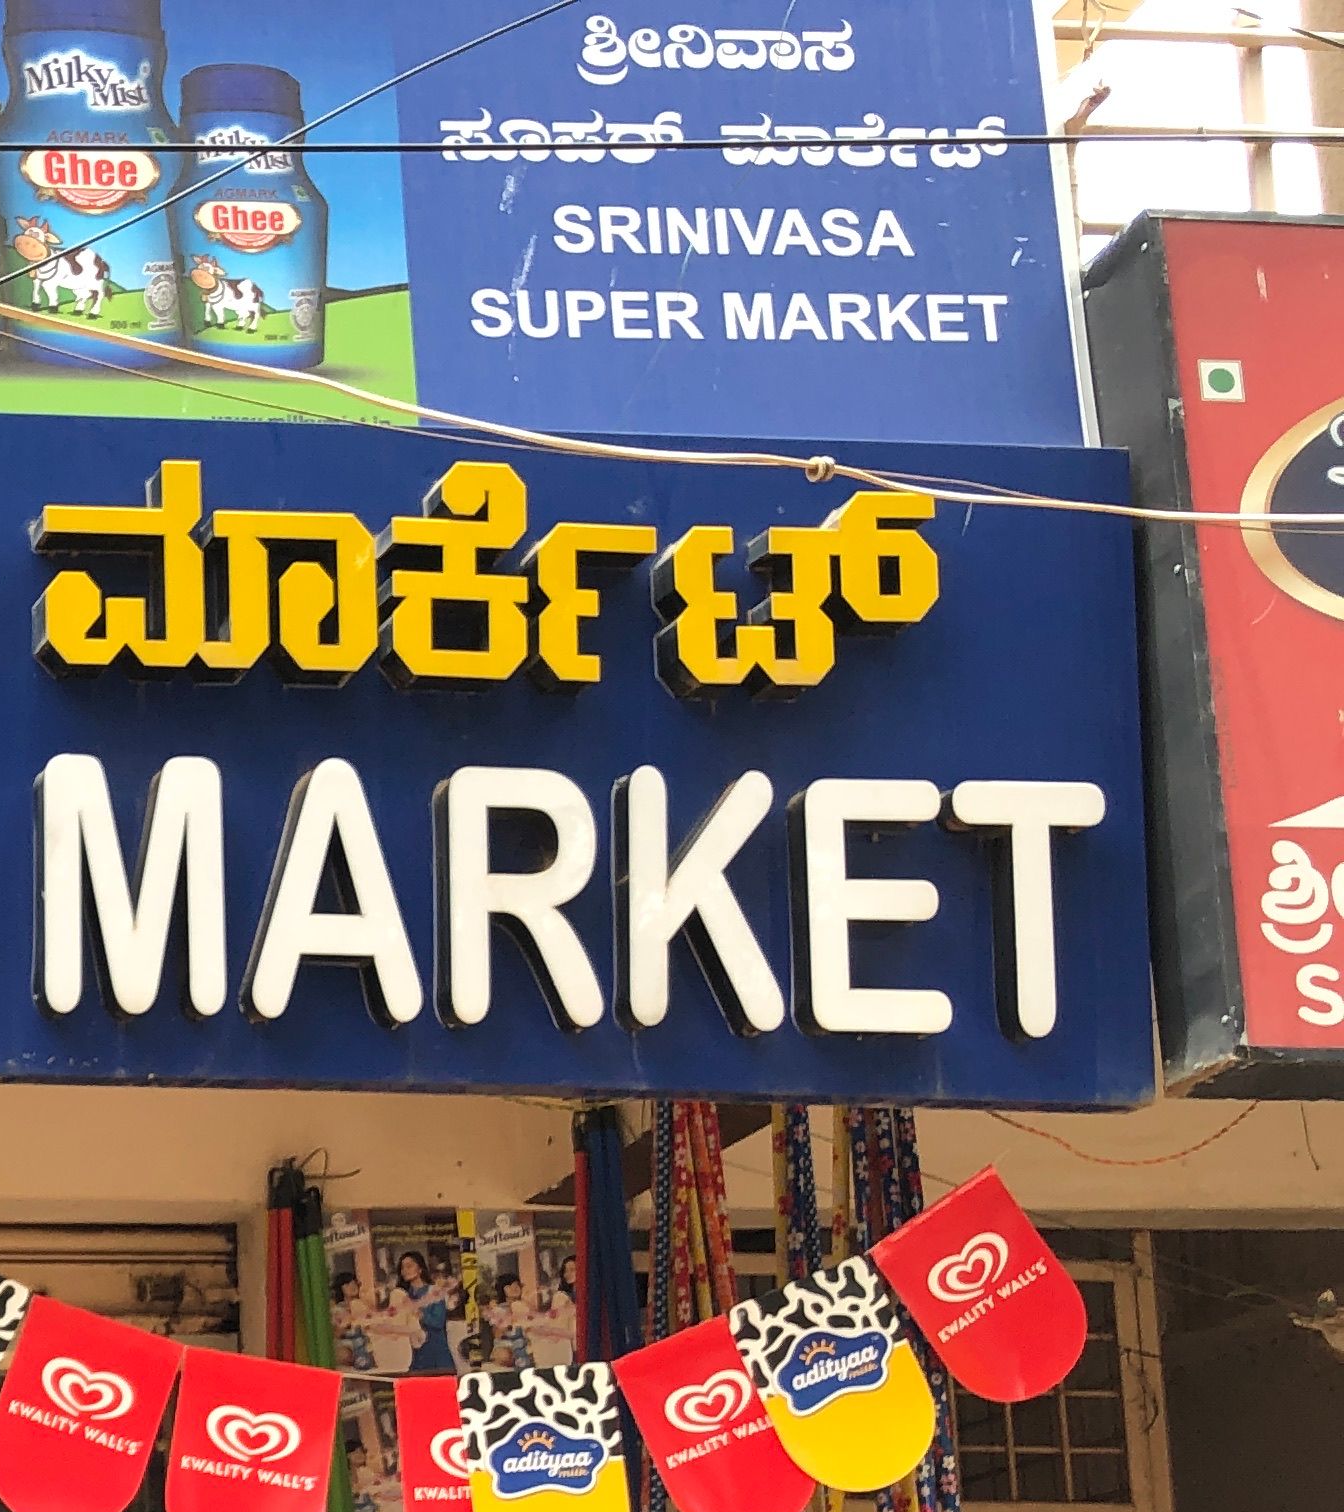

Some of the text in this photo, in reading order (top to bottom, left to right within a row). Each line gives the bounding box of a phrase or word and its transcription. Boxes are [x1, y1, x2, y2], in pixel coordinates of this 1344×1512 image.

[577, 14, 855, 86] ಶ್ರೀನಿವಾಸ
[25, 55, 112, 95] Milky
[91, 81, 148, 107] Mist
[48, 130, 129, 144] AGMARK
[440, 108, 1008, 169] ಸೂಪರ್ ಮಾರ್ಕೆಟ್
[44, 151, 138, 187] Ghee
[213, 204, 286, 231] Ghee
[552, 205, 915, 258] SRINIVASA
[471, 288, 1009, 343] SUPER MARKET
[36, 458, 940, 692] ಮಾರ್ಕೆಟ್
[38, 752, 1108, 1042] MARKET
[936, 1257, 1050, 1345] KWALITY WALL'S
[792, 1344, 880, 1392] adityaa
[7, 1399, 144, 1457] KWALITY WALL'S
[180, 1455, 319, 1492] KWALITY WALL'S
[502, 1448, 593, 1478] adityaa
[665, 1432, 731, 1471] KWALITY
[413, 1486, 472, 1502] KWALIT
